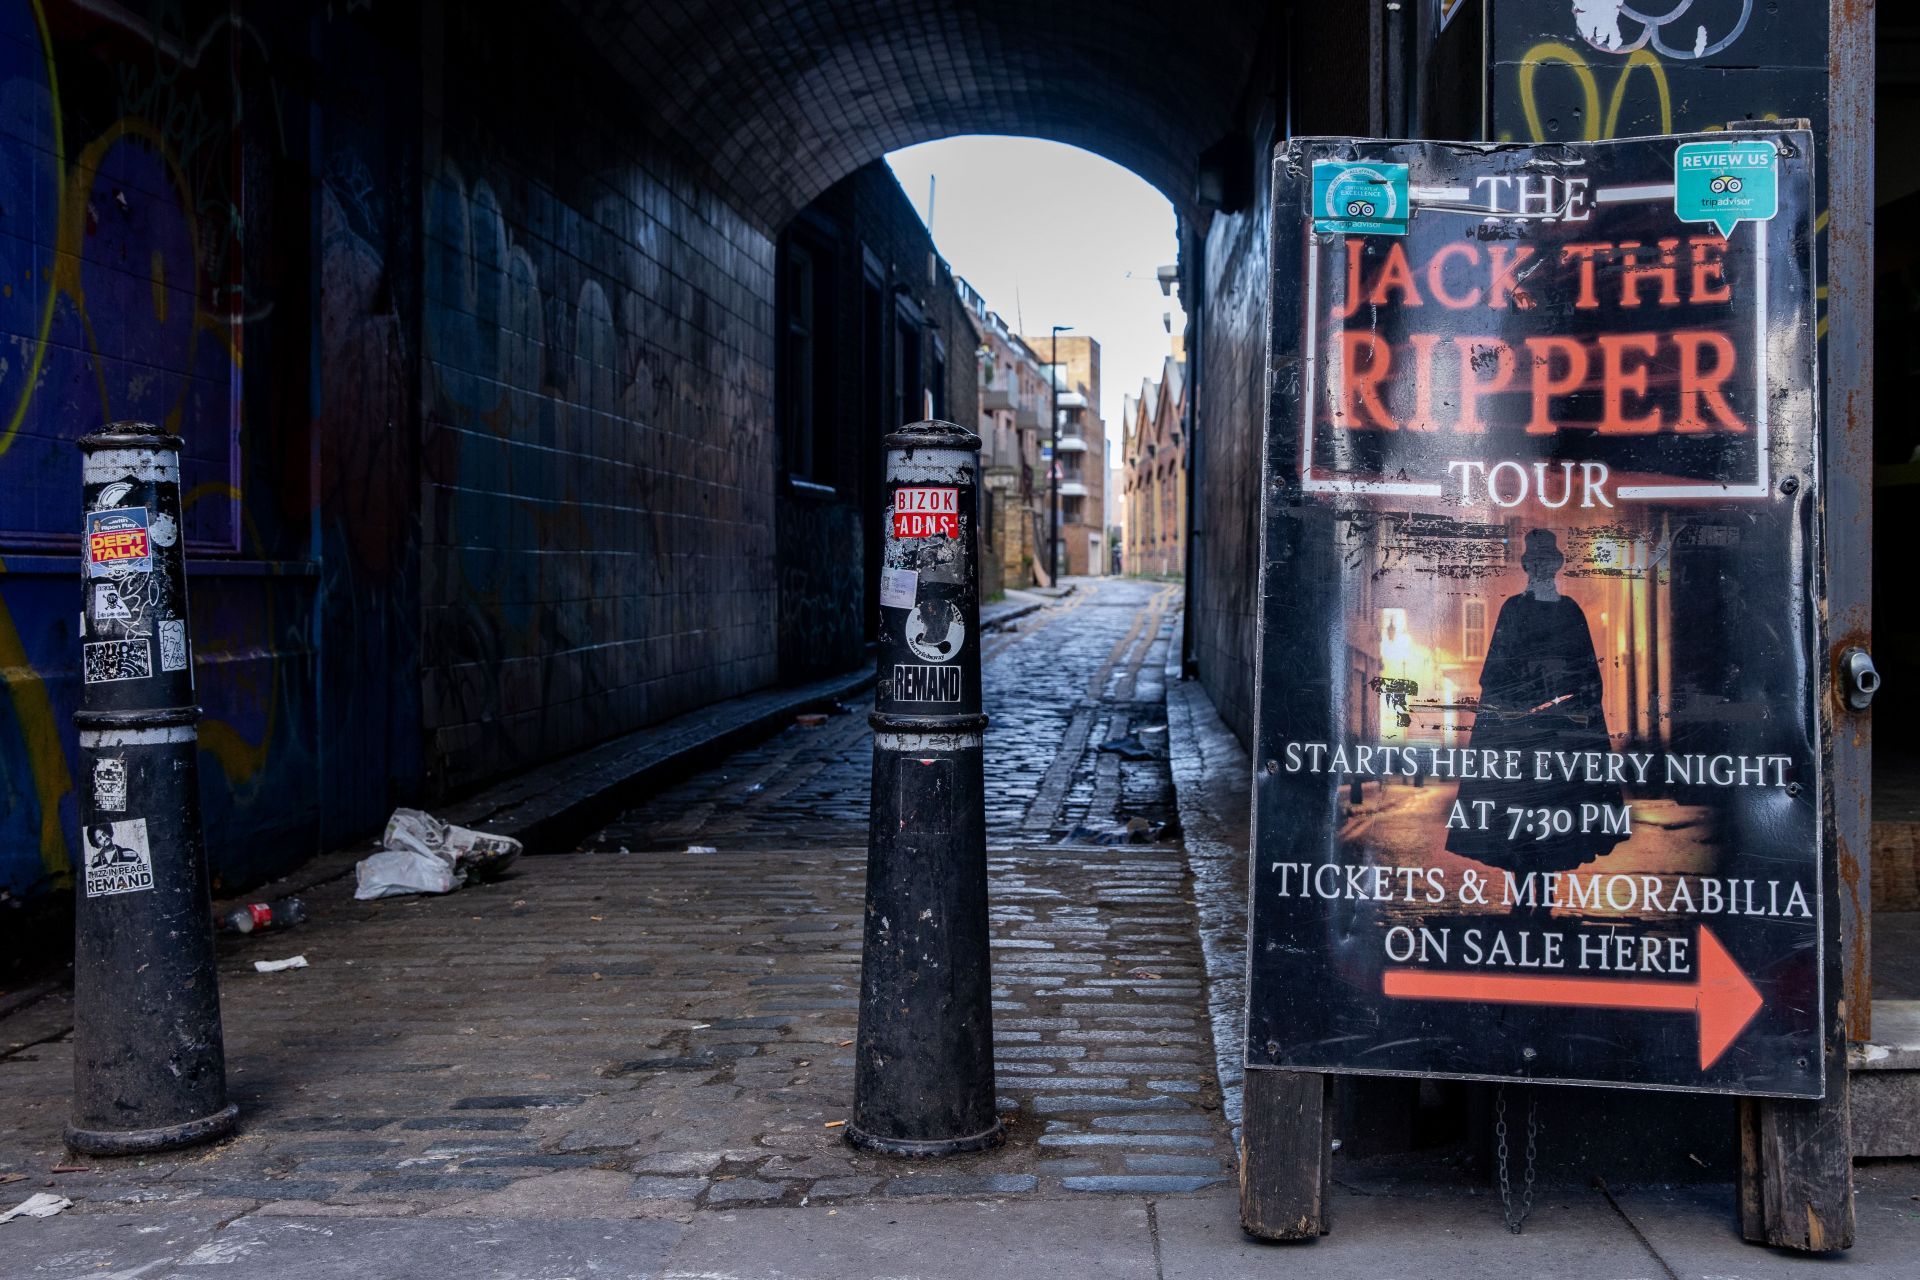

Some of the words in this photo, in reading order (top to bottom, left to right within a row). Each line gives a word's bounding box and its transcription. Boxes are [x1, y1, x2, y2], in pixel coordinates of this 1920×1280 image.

[1682, 154, 1744, 168] REVIEW
[1748, 153, 1769, 165] US
[1476, 174, 1591, 224] THE
[1701, 198, 1751, 208] tripadvisor
[1330, 239, 1537, 318] JACK
[1562, 237, 1733, 309] THE
[1333, 328, 1749, 435] RIPPER
[898, 491, 953, 511] BIZOK
[1447, 460, 1614, 509] TOUR
[91, 532, 146, 549] DEBT
[93, 544, 146, 561] TALK
[894, 666, 960, 701] REMAND
[1285, 742, 1419, 777] STARTS
[1430, 747, 1523, 781] HERE
[1535, 751, 1655, 785] EVERY
[1666, 754, 1792, 787] NIGHT
[1446, 799, 1496, 831] AT
[1506, 804, 1573, 841] 7:30
[1583, 803, 1634, 835] PM
[88, 872, 152, 893] REMAND
[109, 868, 117, 876] IN
[119, 863, 148, 875] PEACE
[1272, 862, 1445, 904] TICKETS
[1458, 870, 1489, 905] &
[1501, 871, 1814, 918] MEMORABILIA
[1385, 926, 1449, 963] ON
[1463, 929, 1566, 969] SALE
[1579, 934, 1690, 975] HERE
